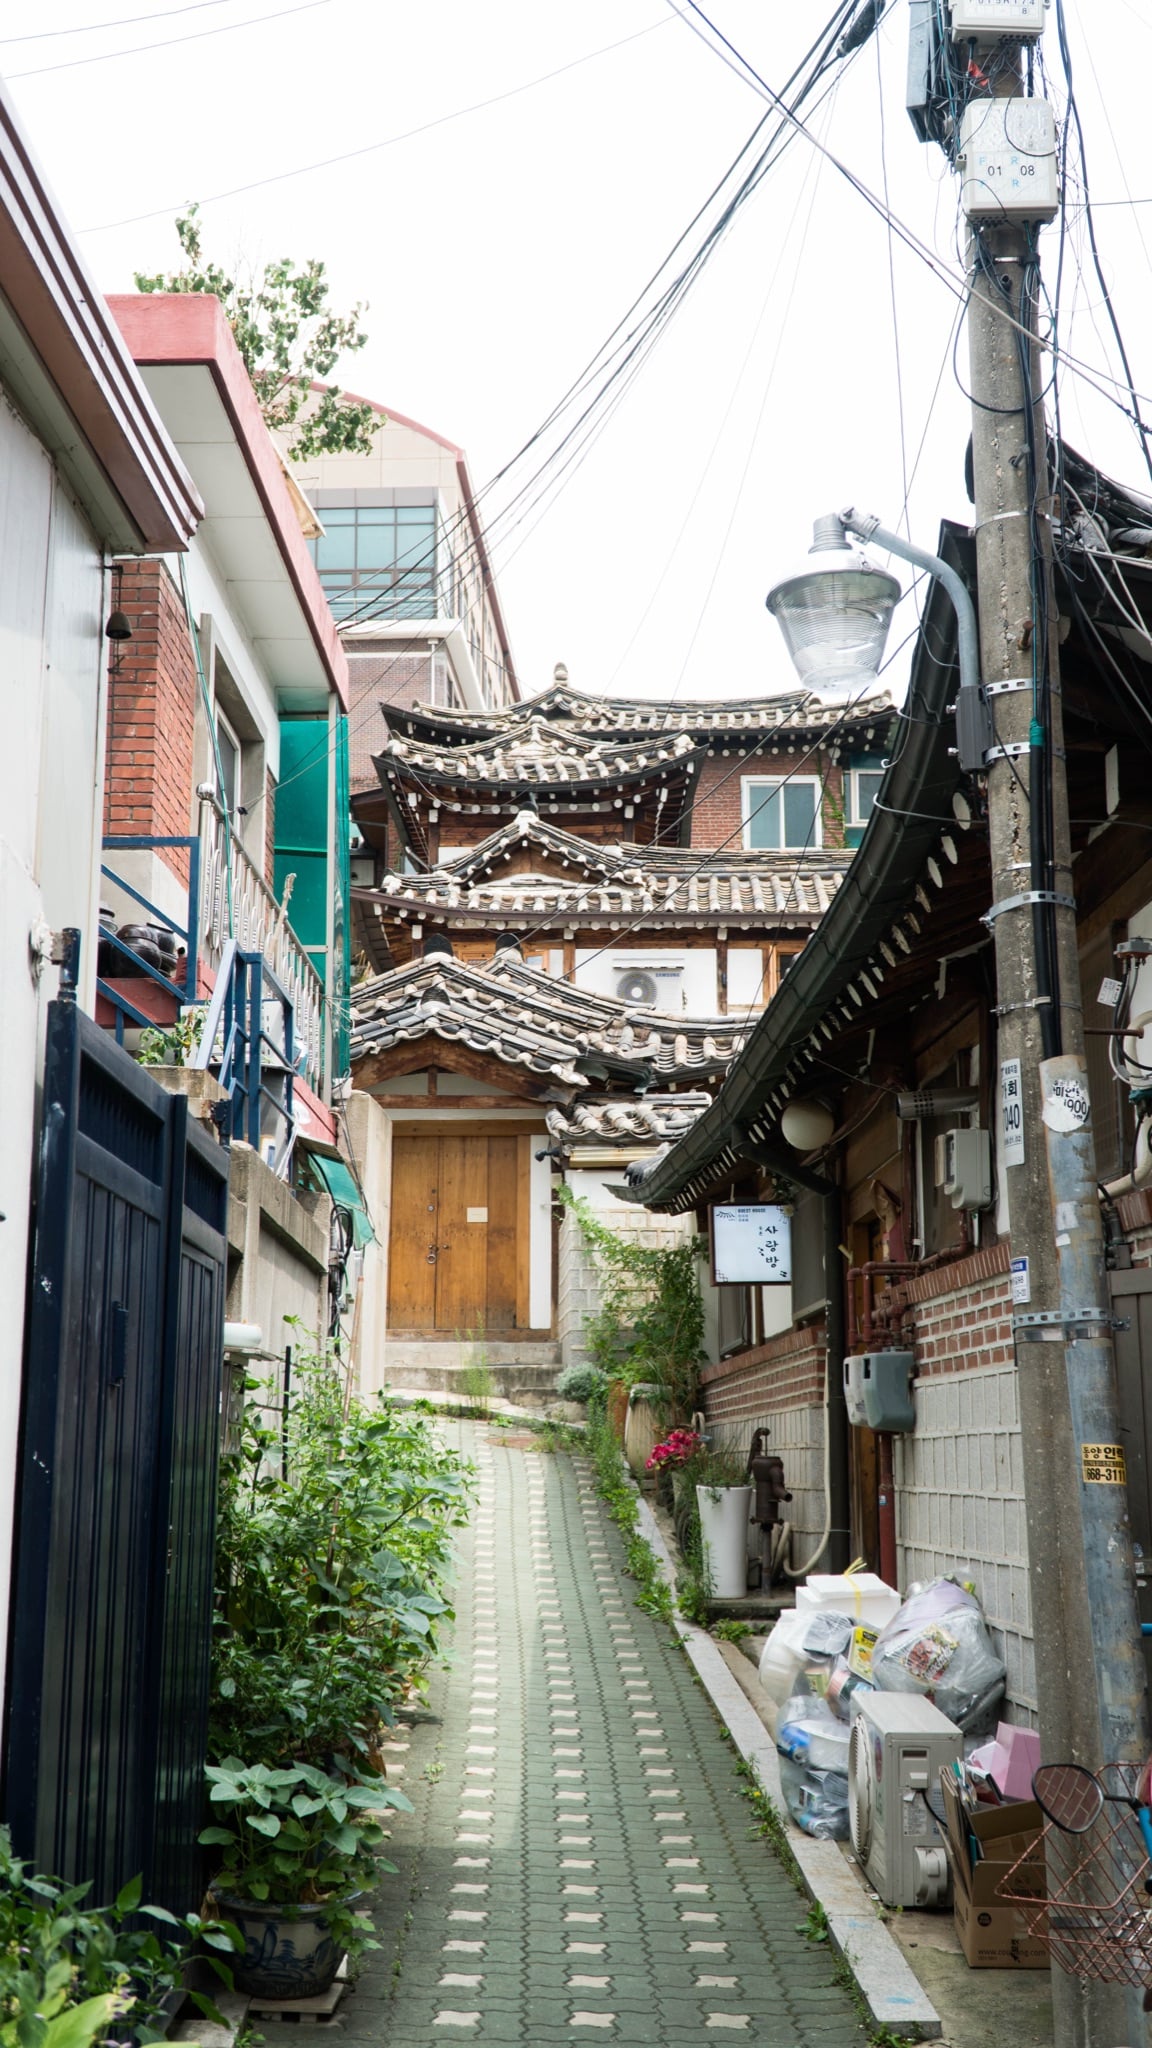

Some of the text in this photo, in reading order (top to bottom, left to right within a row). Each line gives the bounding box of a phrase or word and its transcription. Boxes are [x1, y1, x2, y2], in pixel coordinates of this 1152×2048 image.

[987, 165, 1035, 176] 01 08
[765, 1226, 780, 1268] 사랑방
[1083, 1446, 1102, 1459] 동양
[978, 1949, 1046, 1957] www.coung.com
